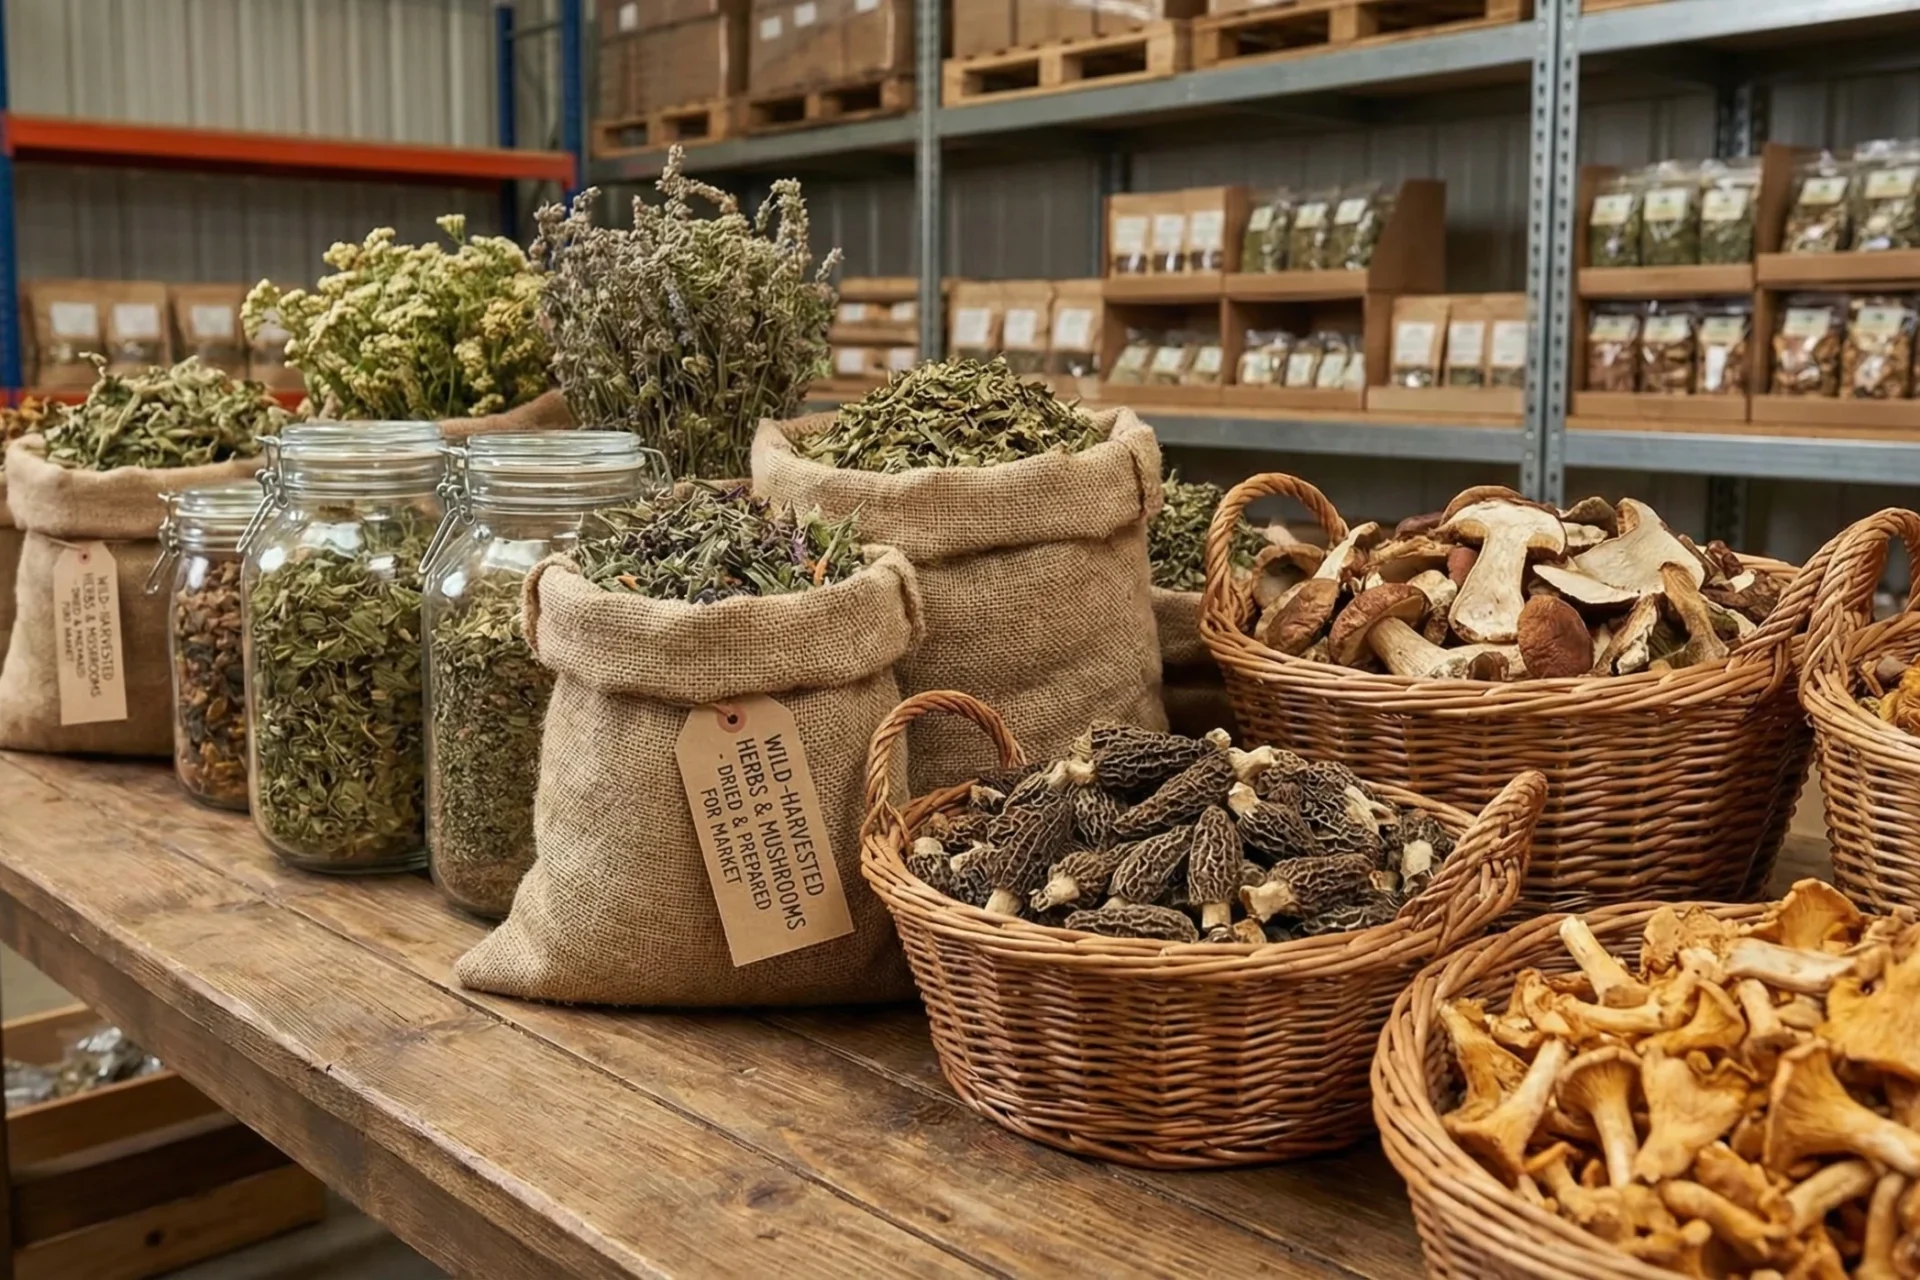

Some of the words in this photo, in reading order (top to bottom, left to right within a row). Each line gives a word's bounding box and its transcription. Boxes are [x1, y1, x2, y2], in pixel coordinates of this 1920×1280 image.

[717, 763, 744, 811] DRIED
[736, 737, 768, 797] HERBS
[700, 788, 722, 818] FOR
[711, 822, 742, 884] MARKET
[732, 816, 748, 828] &
[753, 802, 773, 817] &
[764, 733, 825, 896] WILD-HARVESTED
[736, 831, 772, 911] PREPARED
[758, 820, 806, 931] MUSHROOMS
